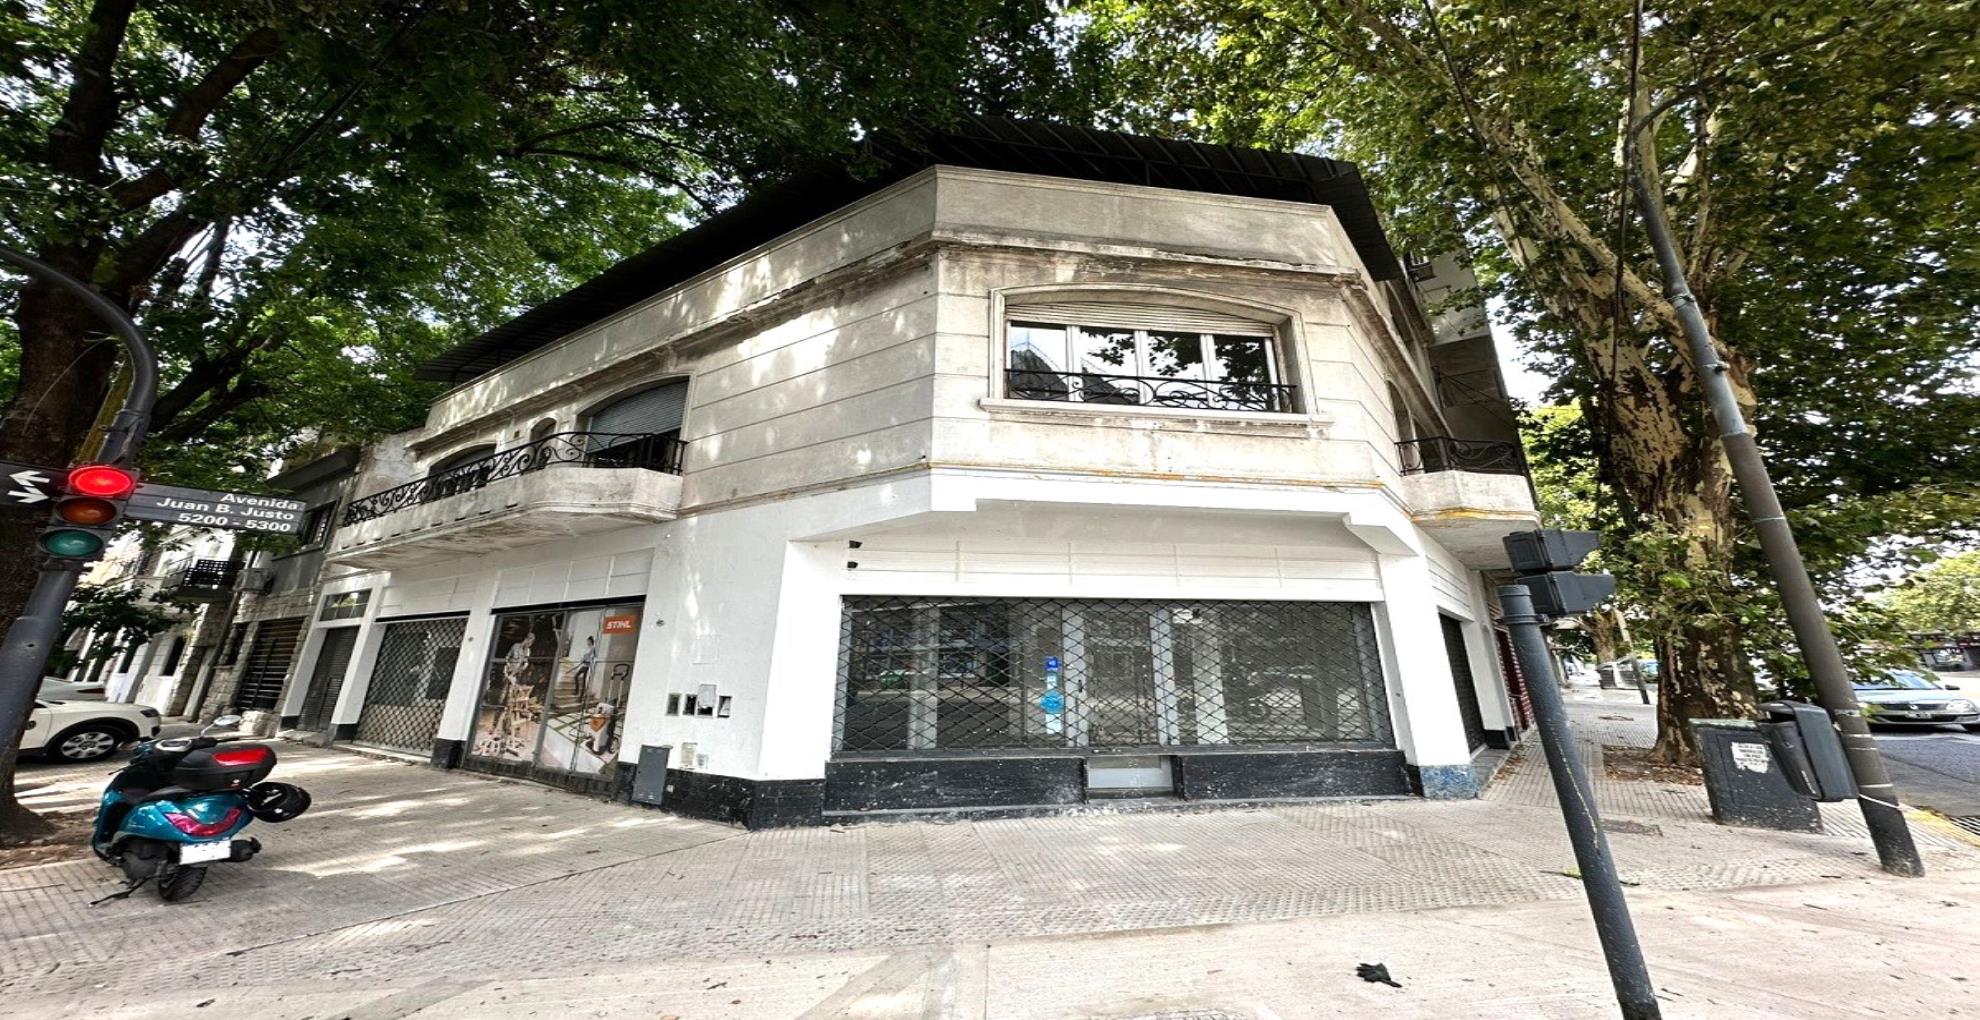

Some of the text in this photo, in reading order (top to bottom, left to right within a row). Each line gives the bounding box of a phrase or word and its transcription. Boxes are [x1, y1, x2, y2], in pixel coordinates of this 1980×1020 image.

[156, 498, 295, 520] Juan B. Justo
[220, 493, 298, 510] Avenida
[178, 513, 228, 526] 5200
[245, 519, 292, 532] 5300
[606, 620, 632, 629] STIHL
